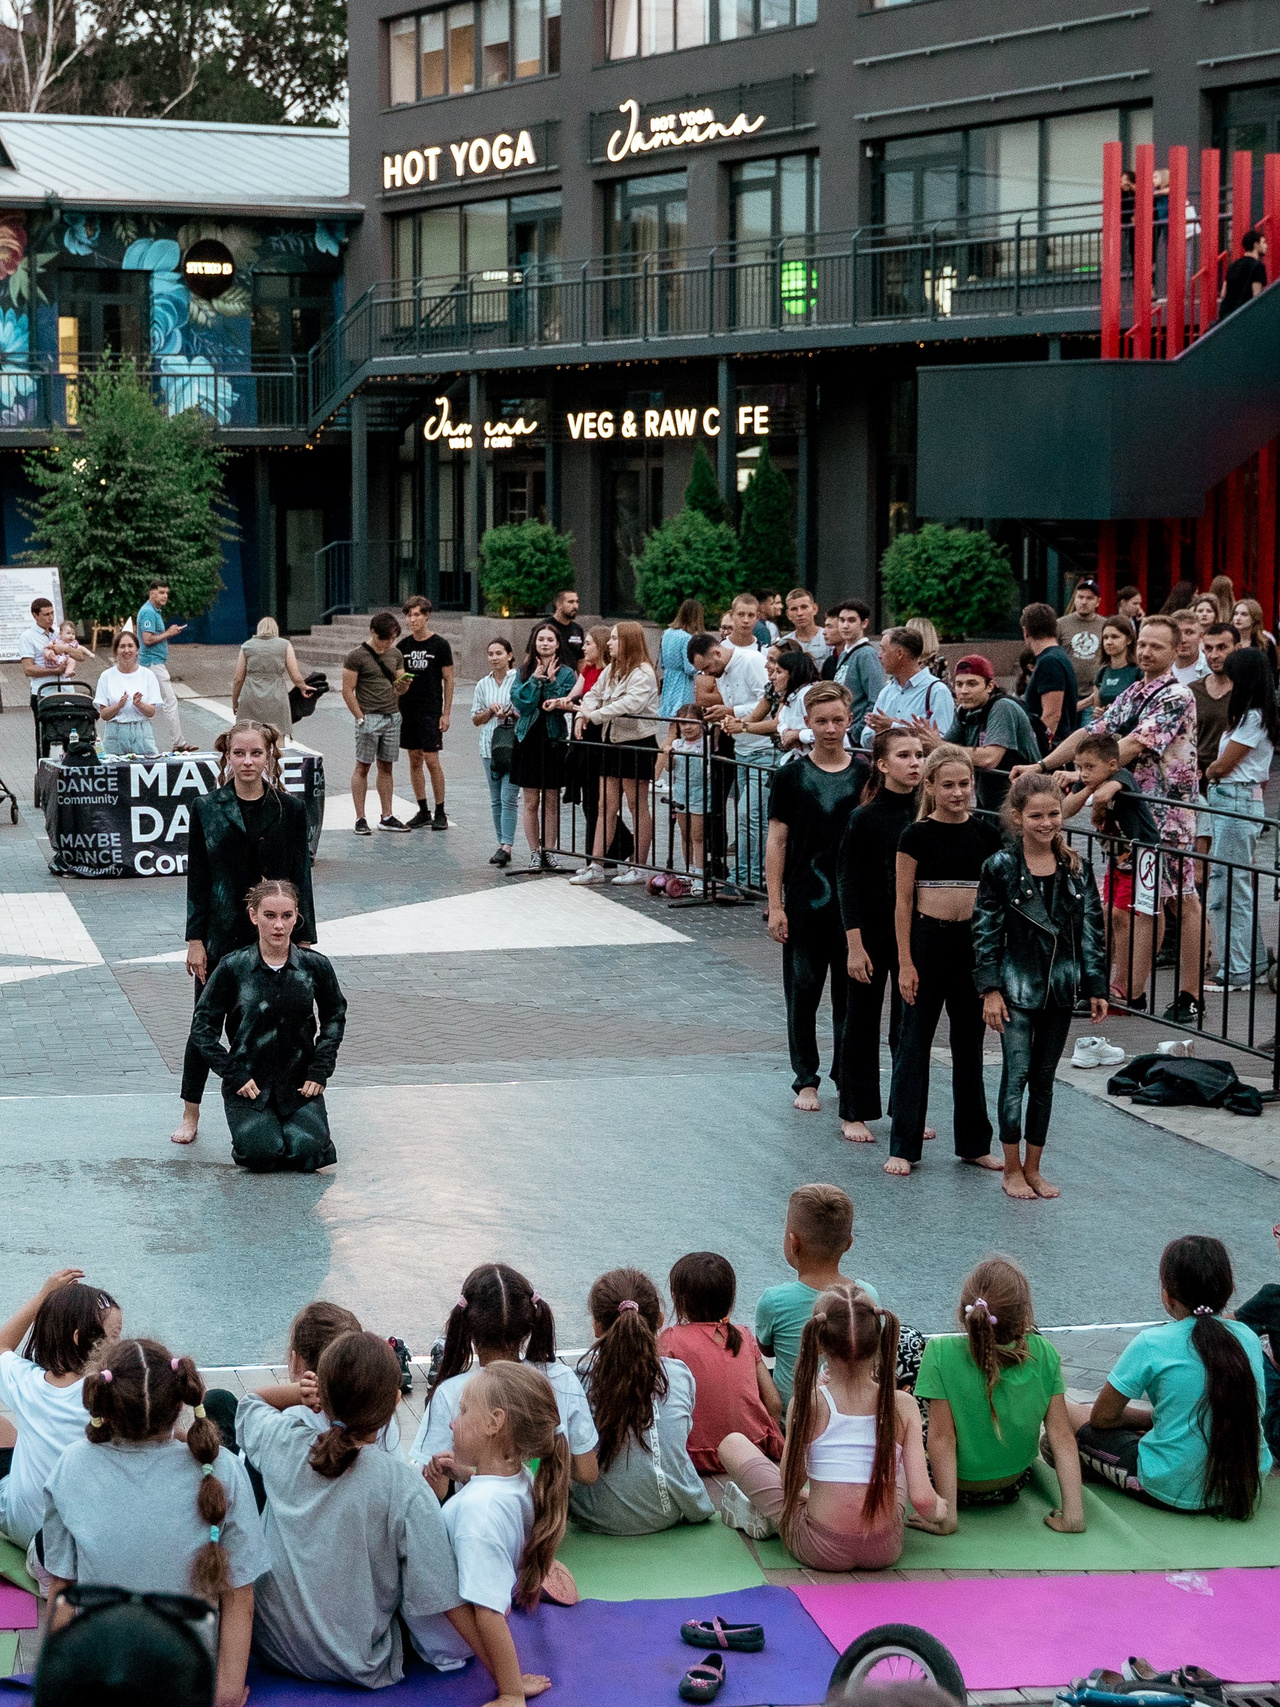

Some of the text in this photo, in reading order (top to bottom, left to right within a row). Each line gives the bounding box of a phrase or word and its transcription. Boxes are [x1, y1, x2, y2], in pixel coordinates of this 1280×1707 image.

[650, 114, 676, 133] HOT
[383, 130, 537, 189] HOT YOGA
[567, 405, 770, 439] VEG & RAW CFE
[56, 777, 119, 793] DANCE
[57, 794, 119, 806] Community
[60, 832, 122, 849] MAYBE
[61, 849, 124, 864] DANCE
